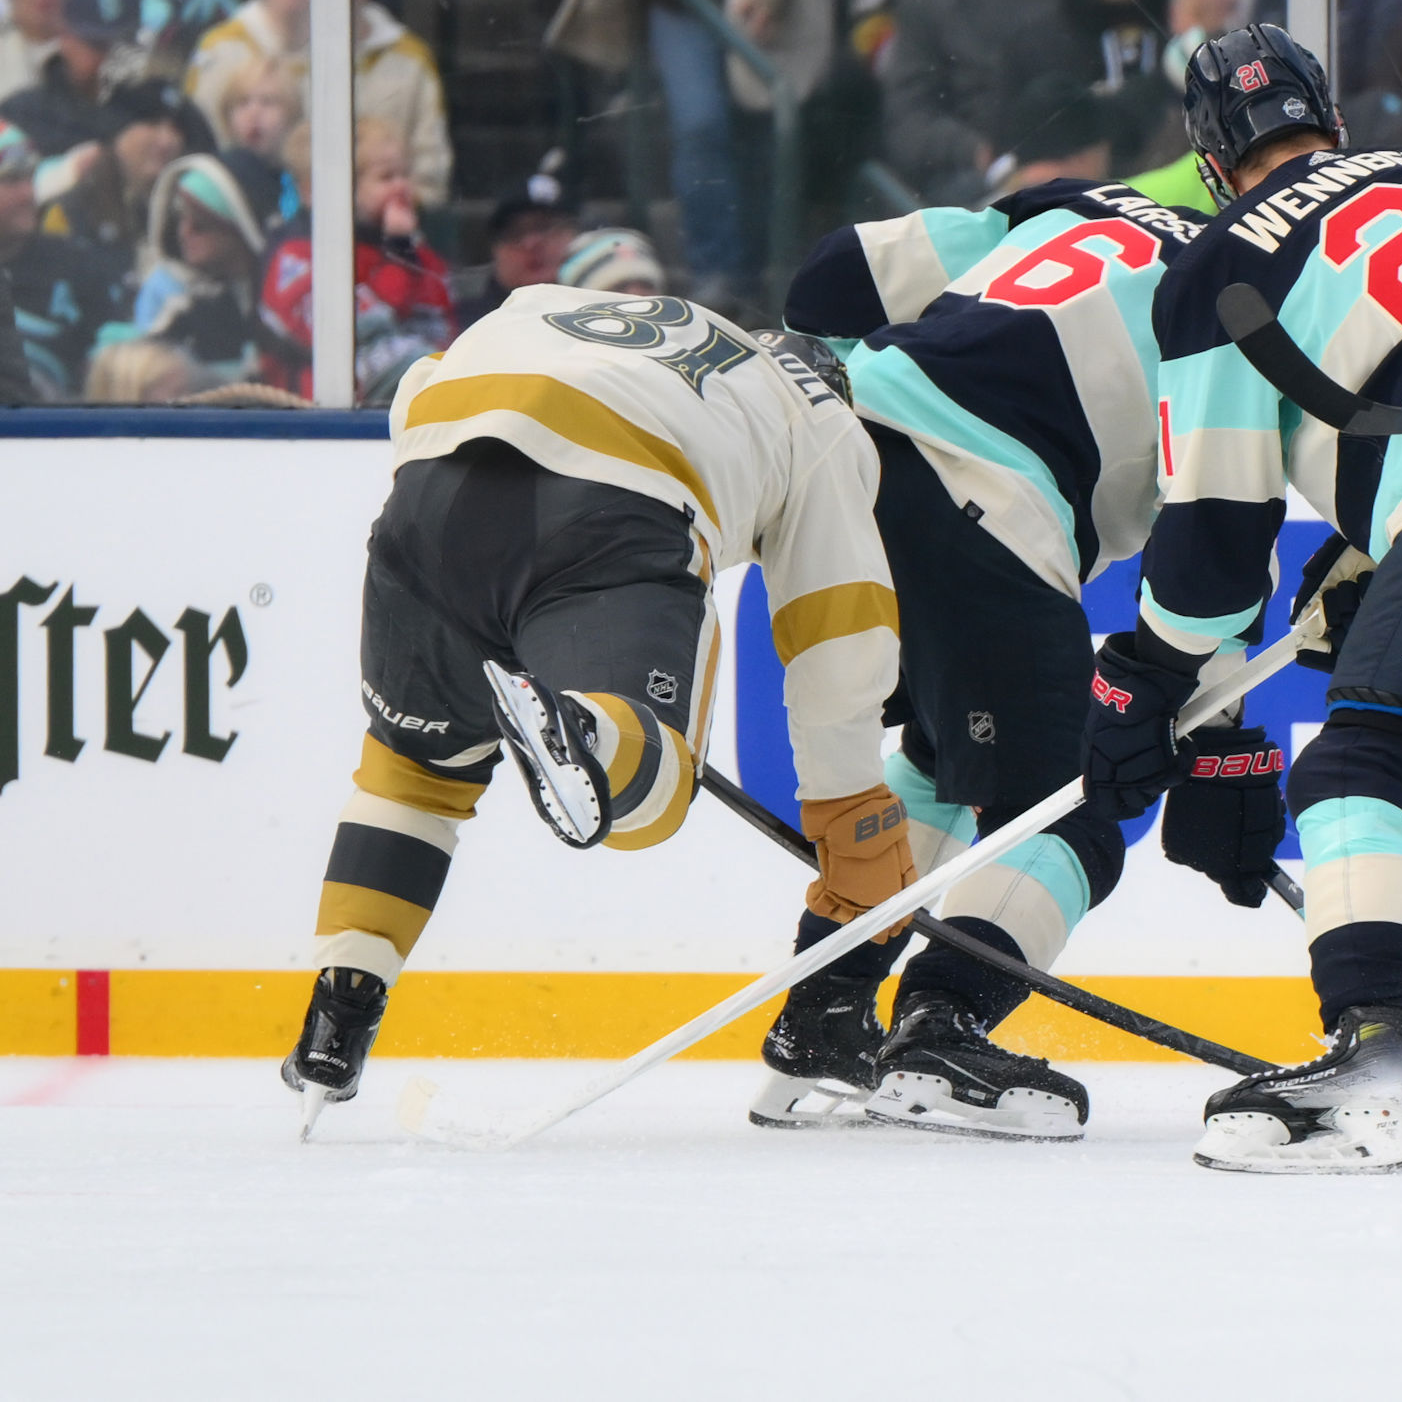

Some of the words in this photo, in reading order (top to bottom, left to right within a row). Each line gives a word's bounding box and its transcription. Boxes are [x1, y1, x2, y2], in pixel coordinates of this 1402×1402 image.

[1236, 60, 1270, 94] 21
[979, 216, 1163, 310] 6
[542, 295, 757, 402] 81
